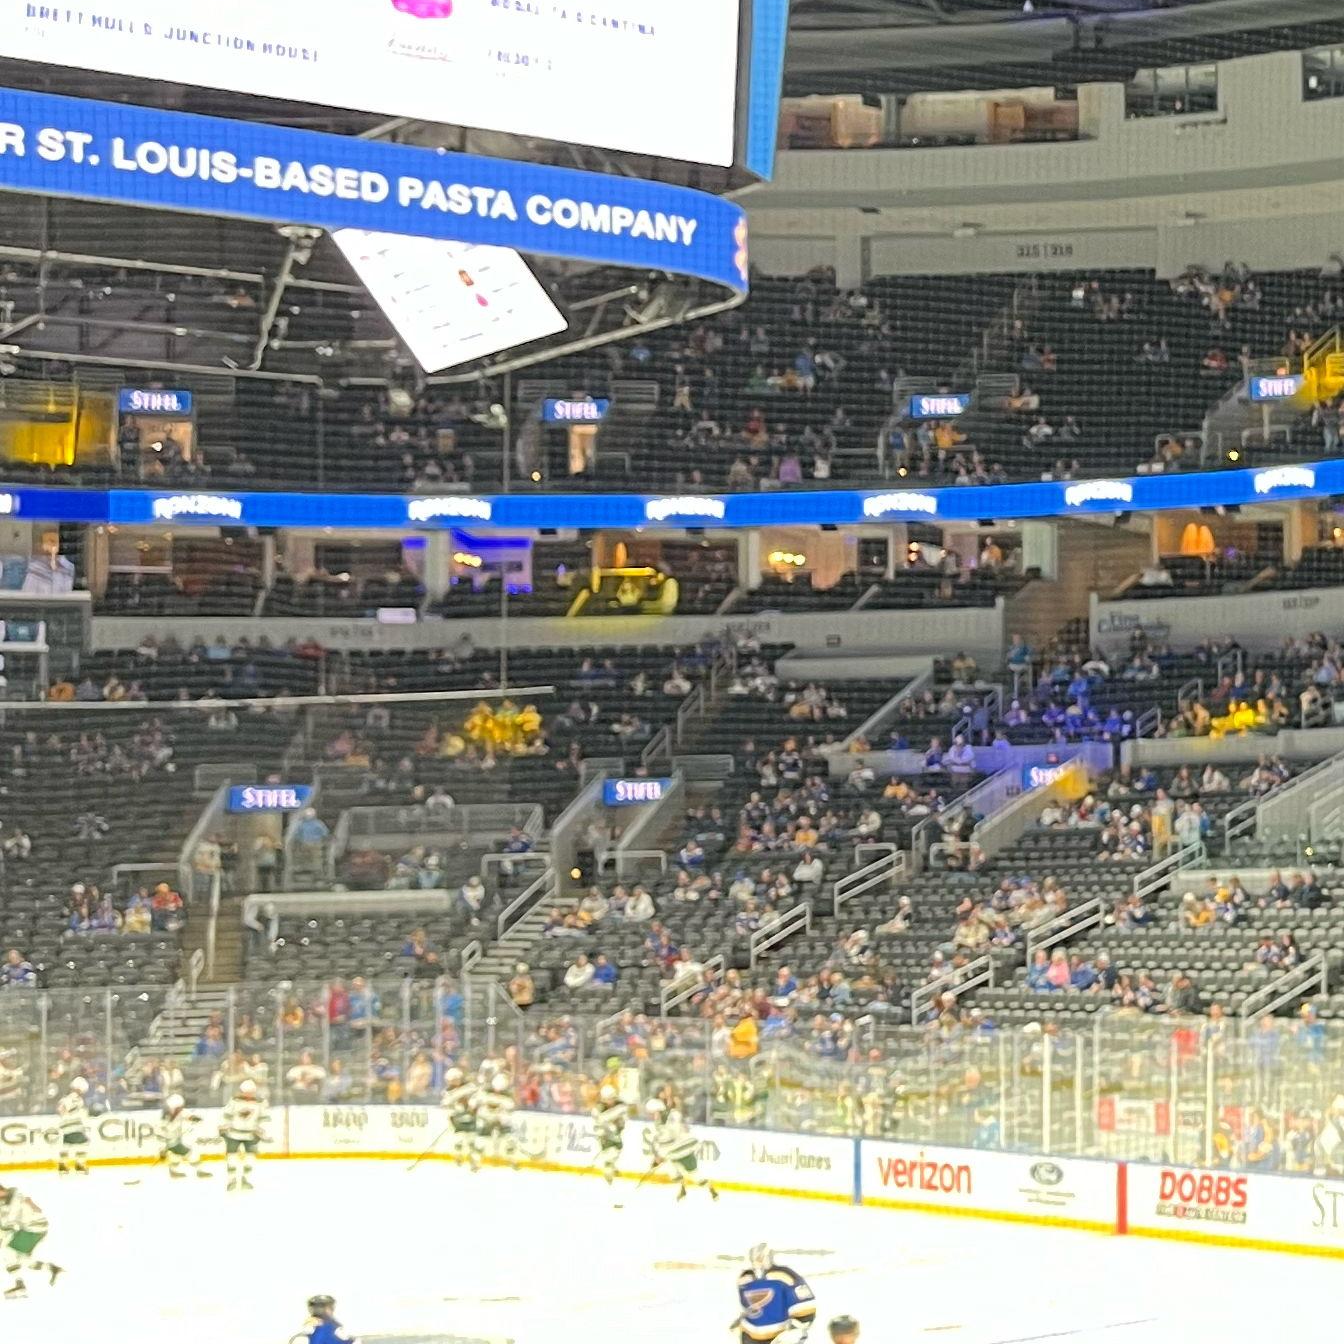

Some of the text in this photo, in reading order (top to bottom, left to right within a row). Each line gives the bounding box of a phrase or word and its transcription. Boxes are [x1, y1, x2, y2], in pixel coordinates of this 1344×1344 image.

[38, 127, 100, 167] ST.
[113, 138, 389, 204] LOUIS-BASED
[398, 176, 517, 223] PASTA
[526, 194, 697, 246] COMPANY
[100, 1118, 158, 1150] Clip
[877, 1151, 972, 1194] verizon
[1158, 1170, 1248, 1208] DOBBS
